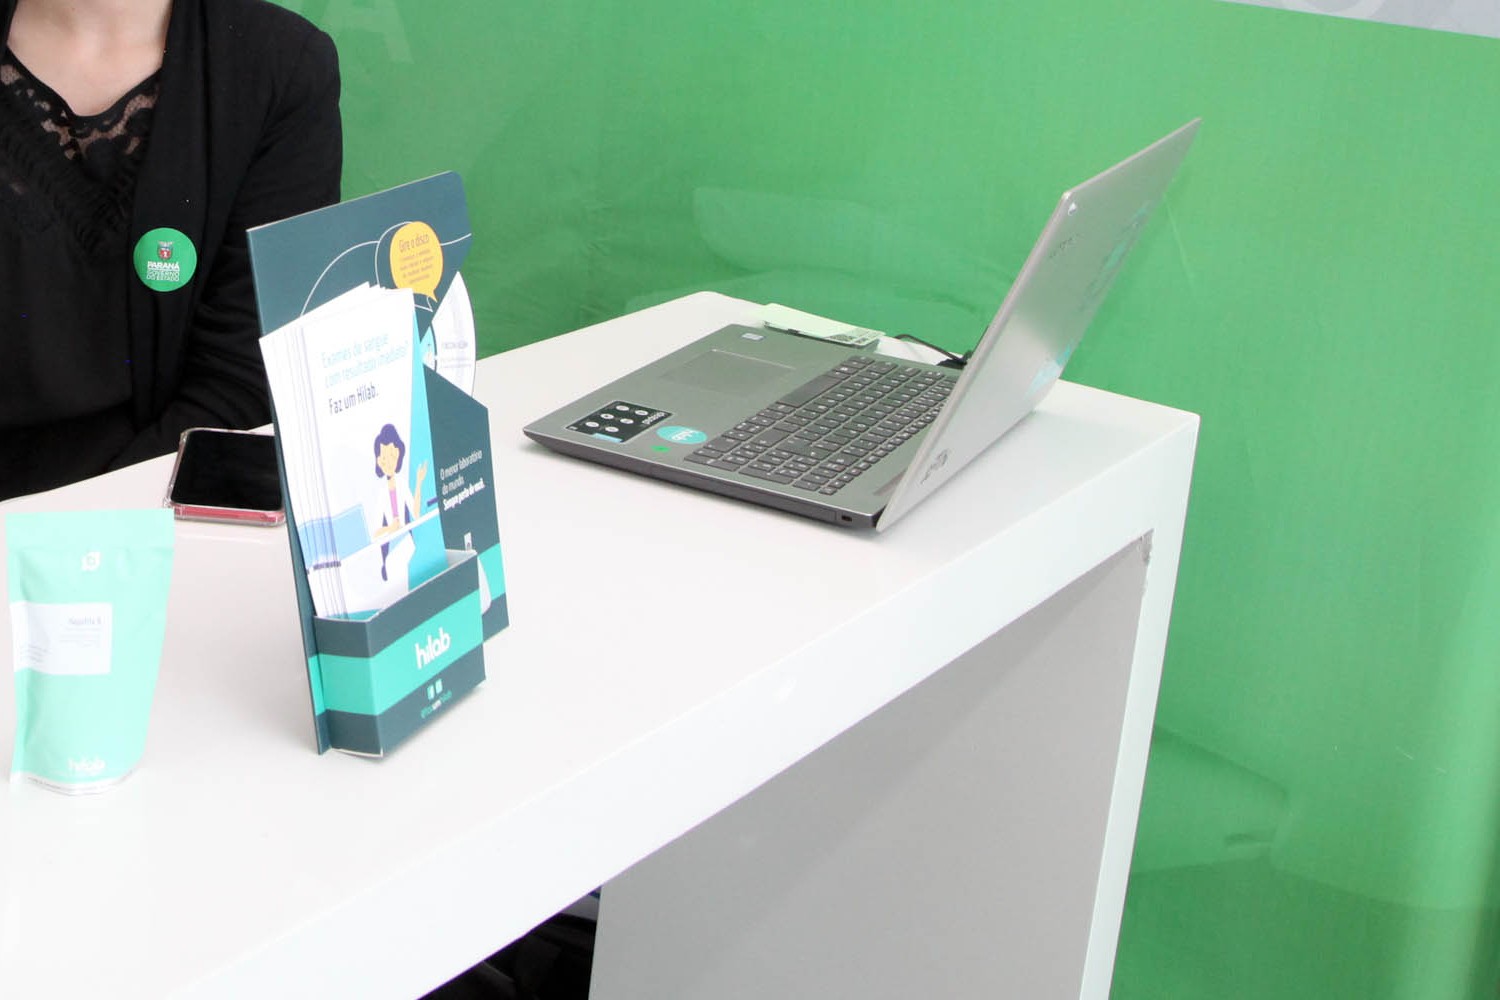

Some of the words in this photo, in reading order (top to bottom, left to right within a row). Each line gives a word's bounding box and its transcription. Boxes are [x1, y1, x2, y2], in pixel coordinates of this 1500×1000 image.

[146, 260, 181, 270] PARANÁ
[328, 398, 343, 415] Faz
[344, 393, 356, 409] um
[414, 626, 452, 670] hilab
